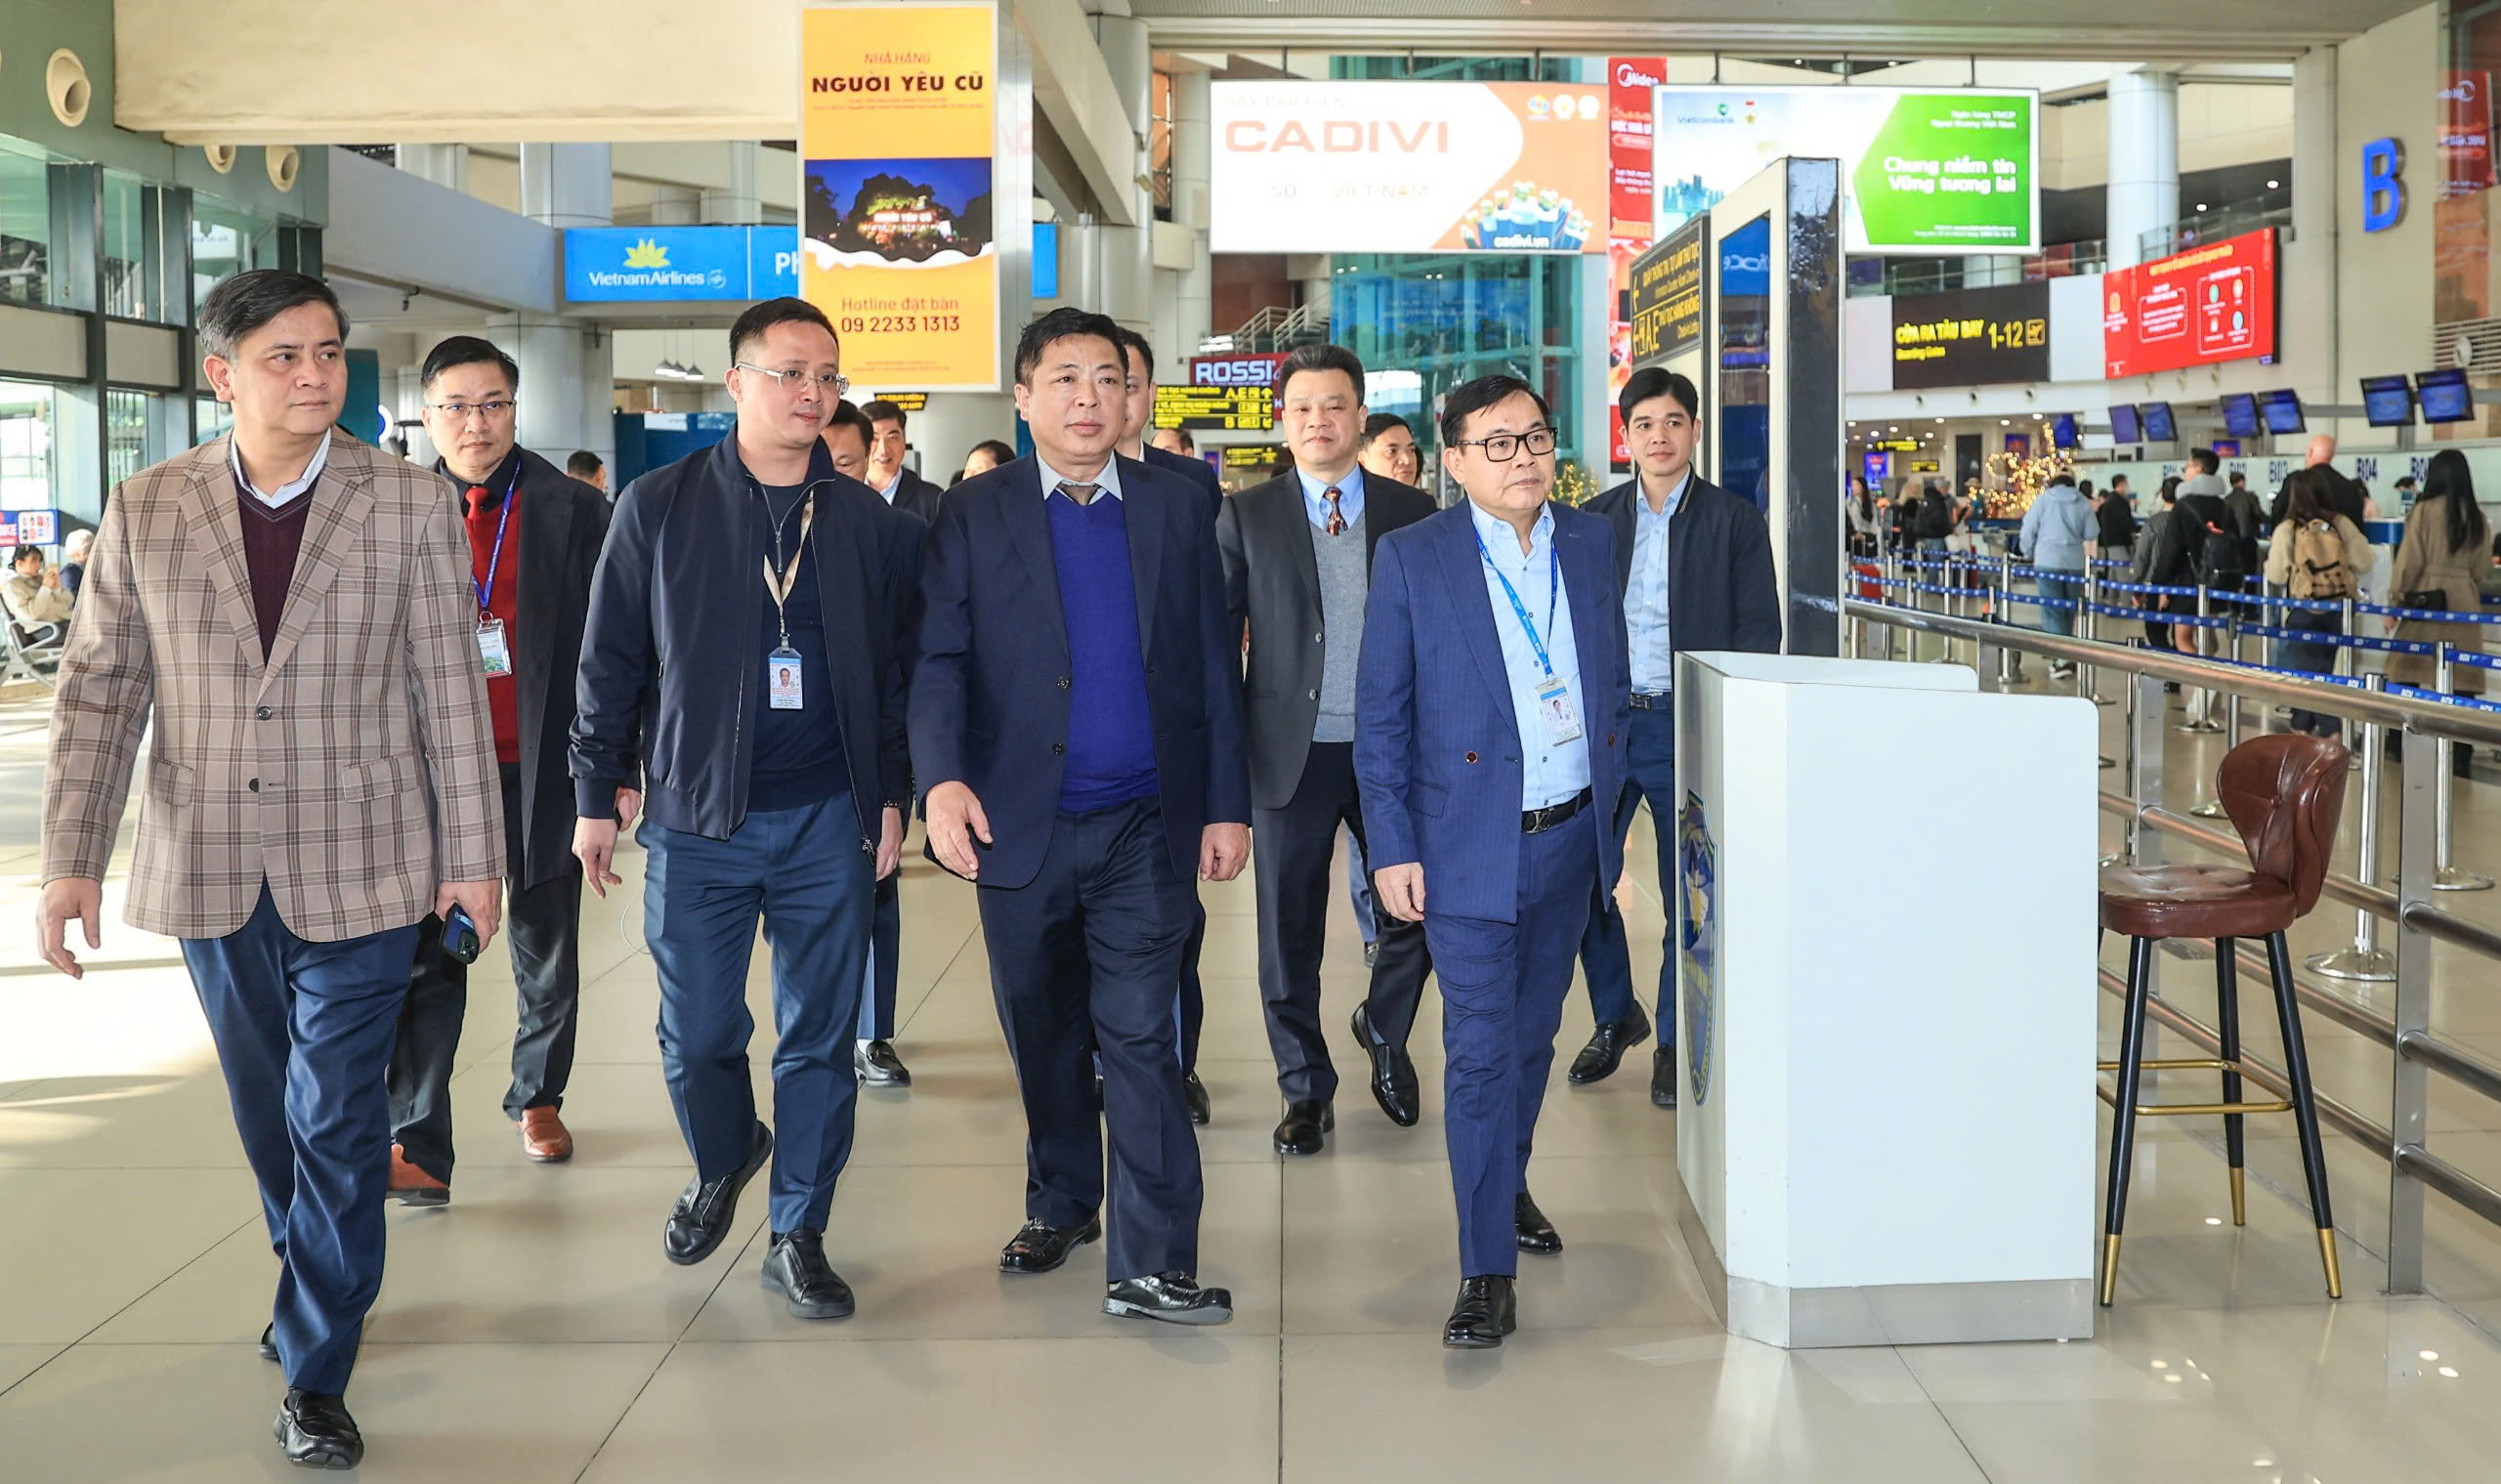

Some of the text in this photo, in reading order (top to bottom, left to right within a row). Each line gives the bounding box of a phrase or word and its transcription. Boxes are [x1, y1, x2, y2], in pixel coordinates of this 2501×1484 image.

[901, 70, 944, 92] YÊU
[1677, 114, 1734, 125] Vietcombank
[1225, 119, 1448, 153] CADIVI
[1885, 156, 1939, 176] Chung
[1992, 158, 2016, 174] tin
[1996, 176, 2016, 192] lai
[2362, 138, 2400, 233] B
[842, 297, 897, 312] Hotline
[841, 316, 960, 333] 09 2233 1313
[1988, 319, 2023, 350] 1-12
[1195, 360, 1273, 383] ROSSI
